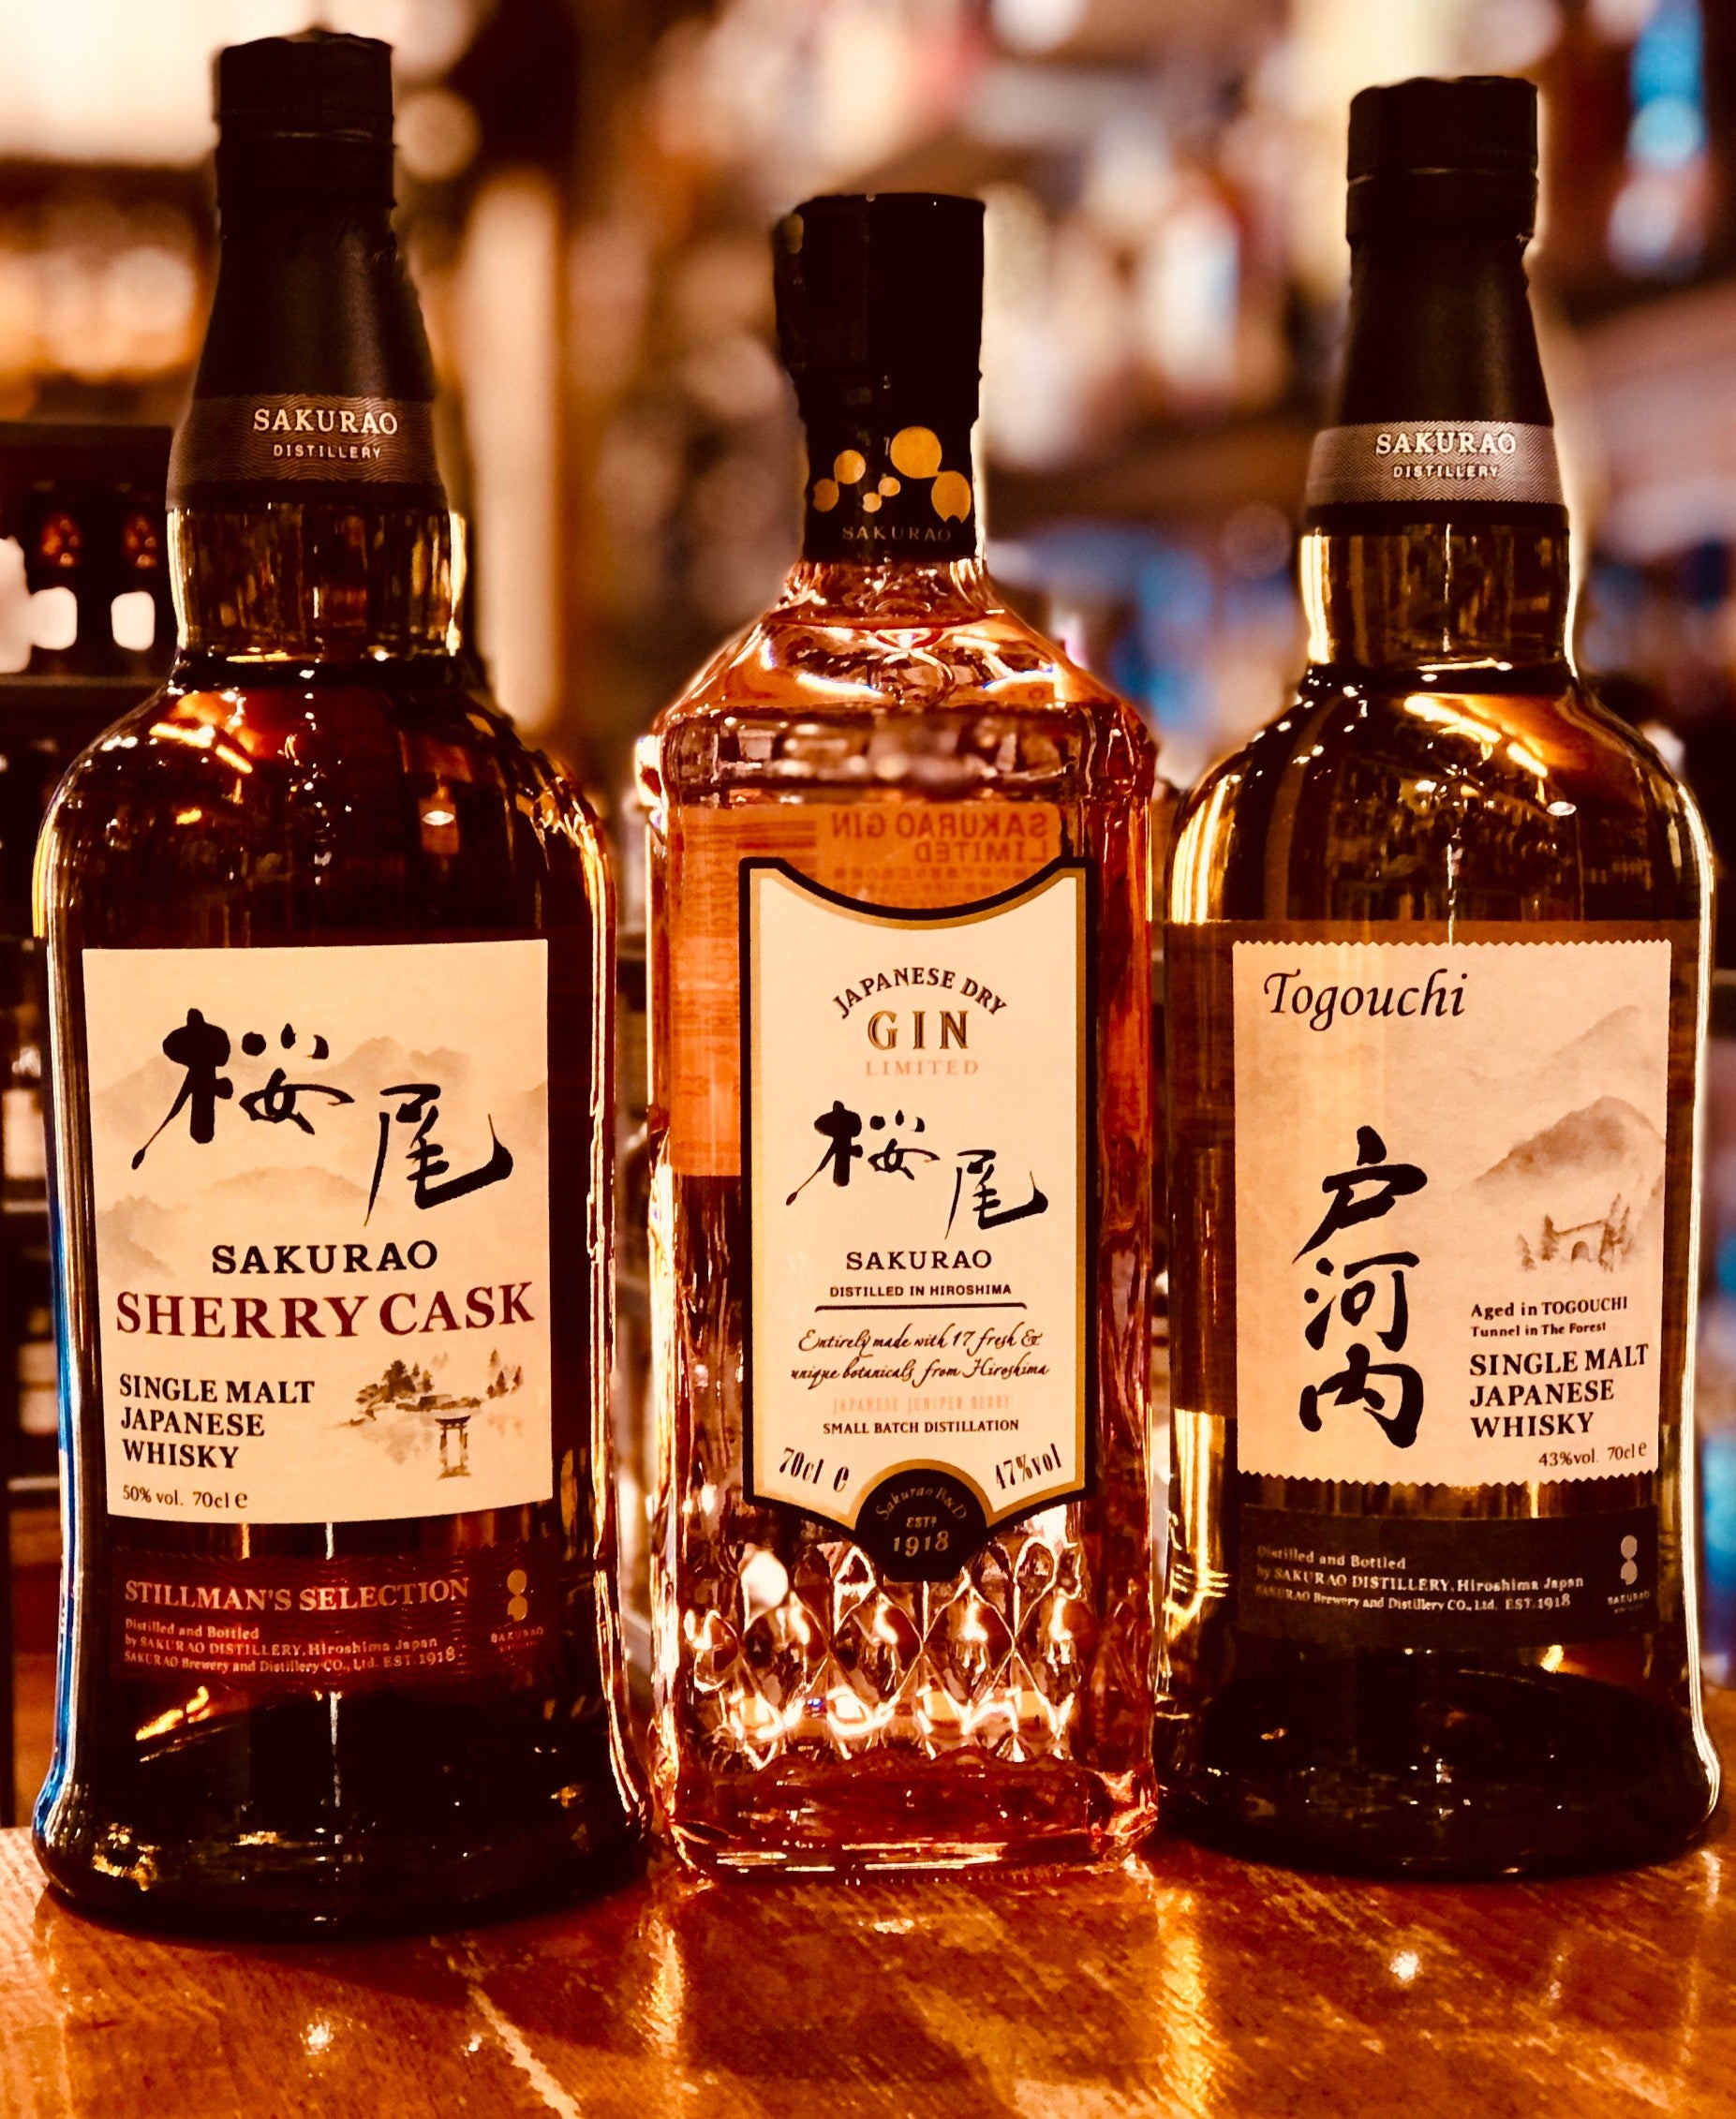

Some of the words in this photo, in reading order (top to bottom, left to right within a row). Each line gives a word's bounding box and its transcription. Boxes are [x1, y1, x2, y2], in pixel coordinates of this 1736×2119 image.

[253, 408, 398, 436] SAKURAO
[274, 444, 381, 461] DISTILLERY
[1375, 431, 1517, 456] SAKURAO
[1393, 465, 1499, 478] DISTILLERY
[842, 526, 952, 541] SAKURAO
[832, 967, 957, 1019] JAPANESE
[959, 977, 1008, 1015] DRY
[1263, 968, 1468, 1031] Togouchi
[867, 1010, 969, 1050] GIN
[865, 1059, 979, 1076] LIMITED
[212, 1239, 438, 1275] SAKURAO
[845, 1250, 992, 1271] SAKURAO
[829, 1285, 904, 1298] DISTILLED
[910, 1285, 925, 1297] IN
[929, 1283, 1012, 1297] HIROSHIMA
[116, 1291, 369, 1339] SHERRY
[378, 1282, 535, 1336] CASK
[1471, 1302, 1514, 1320] Aged
[1521, 1302, 1537, 1316] in
[1541, 1296, 1627, 1315] TOGOUCHI
[798, 1328, 873, 1357] Entirely
[872, 1323, 912, 1349] made
[913, 1323, 956, 1348] with
[952, 1330, 976, 1348] 17
[967, 1321, 1025, 1356] fresh
[1021, 1328, 1043, 1347] &
[1471, 1325, 1521, 1338] Tunnel
[1525, 1325, 1538, 1336] in
[1541, 1323, 1565, 1335] The
[1569, 1322, 1607, 1334] Forest
[791, 1365, 840, 1390] unique
[842, 1356, 916, 1382] botanicals
[912, 1358, 961, 1388] from
[962, 1352, 1050, 1380] Hiroshima
[1470, 1350, 1578, 1376] SINGLE
[1584, 1343, 1649, 1371] MALT
[120, 1373, 217, 1402] SINGLE
[226, 1381, 315, 1403] MALT
[1470, 1379, 1614, 1408] JAPANESE
[833, 1397, 899, 1415] JAPANESE
[907, 1396, 963, 1414] JUNIPER
[121, 1406, 265, 1437] JAPANESE
[823, 1422, 869, 1435] SMALL
[874, 1421, 919, 1434] BATCH
[924, 1419, 1019, 1433] DISTILLATION
[1470, 1411, 1595, 1438] WHISKY
[122, 1439, 239, 1469] WHISKY
[1608, 1444, 1635, 1460] 70cl
[779, 1446, 824, 1485] 70cl
[123, 1485, 151, 1503] 50%
[156, 1489, 184, 1506] vol.
[193, 1491, 230, 1508] 70cl
[875, 1487, 933, 1520] Sakurao
[894, 1531, 949, 1557] 1918
[1257, 1546, 1314, 1563] Distilled
[1319, 1554, 1345, 1566] and
[1350, 1554, 1406, 1570] Bottled
[1274, 1568, 1347, 1587] SAKURAO
[1457, 1578, 1539, 1592] Hiroshima
[1543, 1577, 1584, 1592] Japan
[126, 1579, 291, 1611] STILLMAN'S
[299, 1578, 468, 1611] SELECTION
[1313, 1592, 1360, 1609] Brewery
[1362, 1596, 1385, 1608] and
[1388, 1596, 1446, 1610] Distillery
[126, 1618, 174, 1635] Distilled
[179, 1625, 202, 1637] and
[207, 1625, 259, 1639] Bottled
[126, 1634, 137, 1647] by
[141, 1637, 204, 1653] SAKURAO
[308, 1640, 390, 1655] Hiroshima
[395, 1637, 438, 1652] Japan
[125, 1651, 178, 1667] SAKURAO
[182, 1658, 230, 1674] Brewery
[233, 1660, 255, 1672] and
[260, 1659, 319, 1674] Distillery
